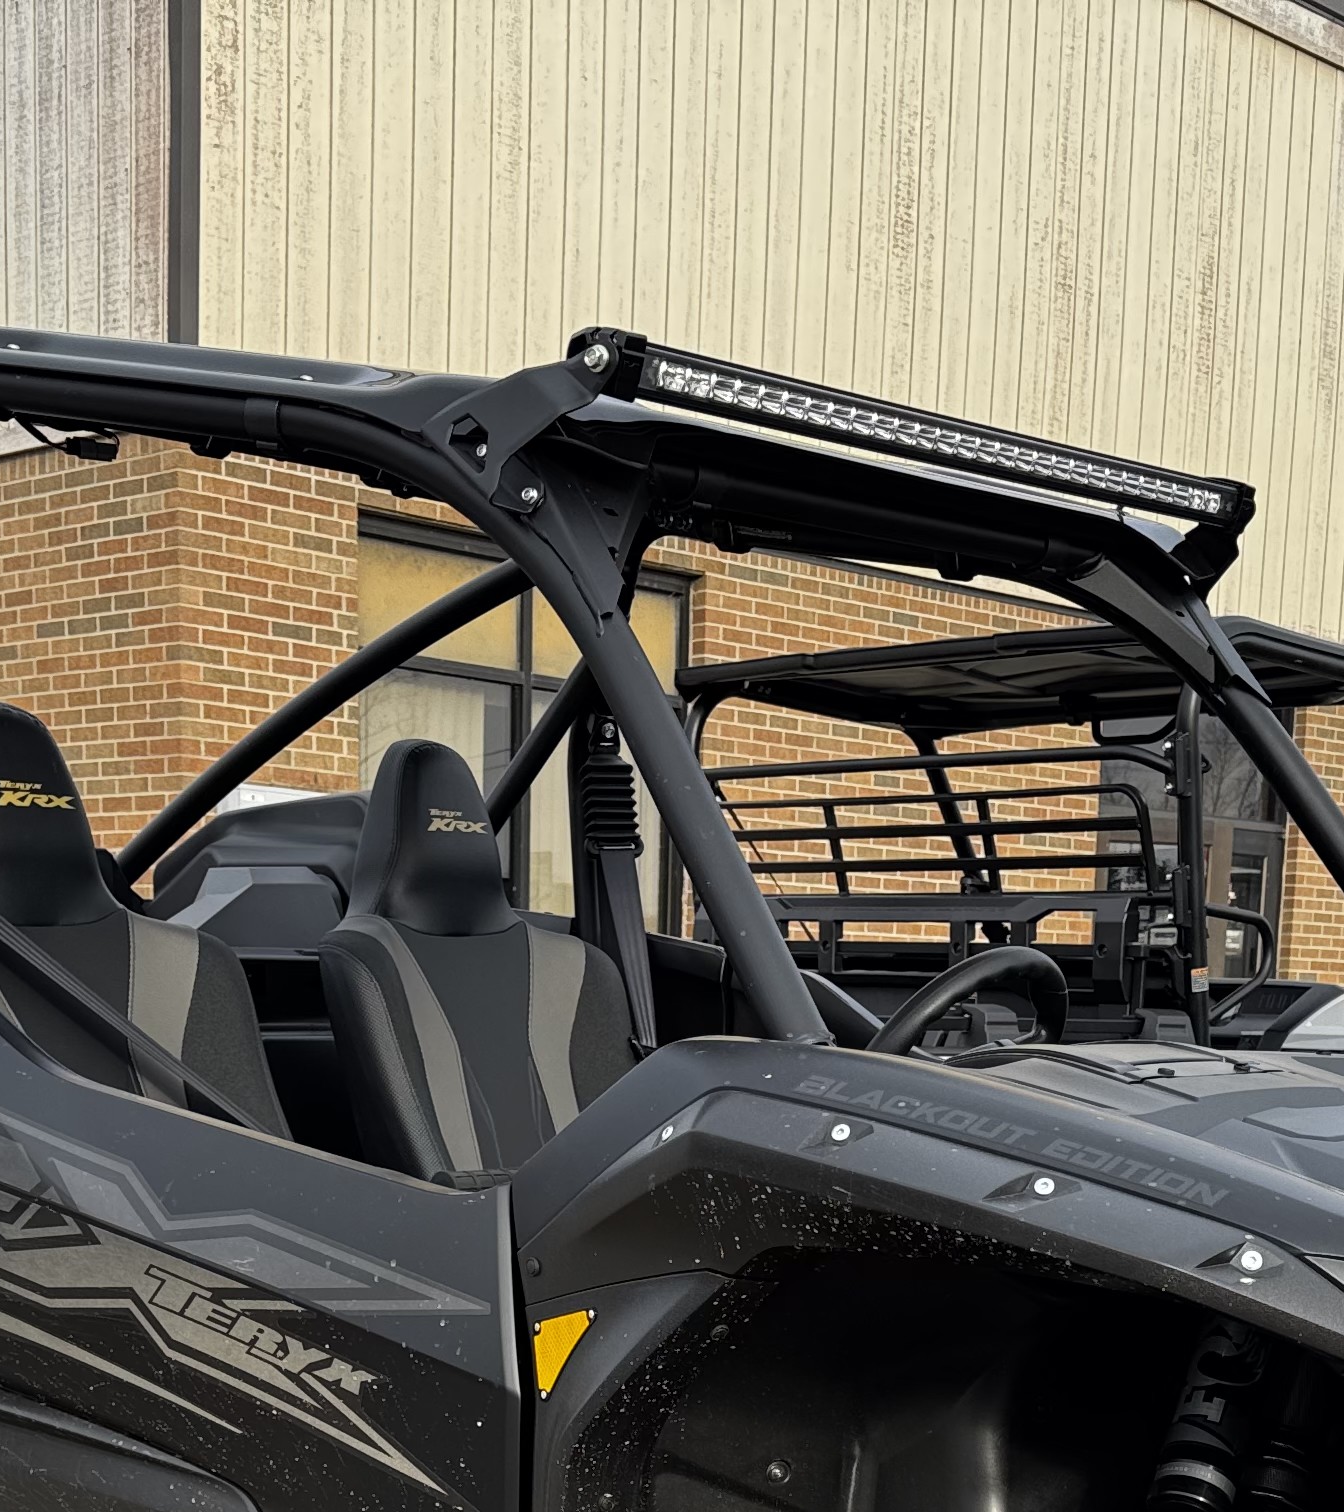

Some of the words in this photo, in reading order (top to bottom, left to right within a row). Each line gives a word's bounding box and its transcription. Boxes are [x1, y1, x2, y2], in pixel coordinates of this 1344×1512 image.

[427, 818, 488, 834] KRX
[794, 1075, 1038, 1145] BLACKOUT
[1041, 1139, 1232, 1207] EDITION
